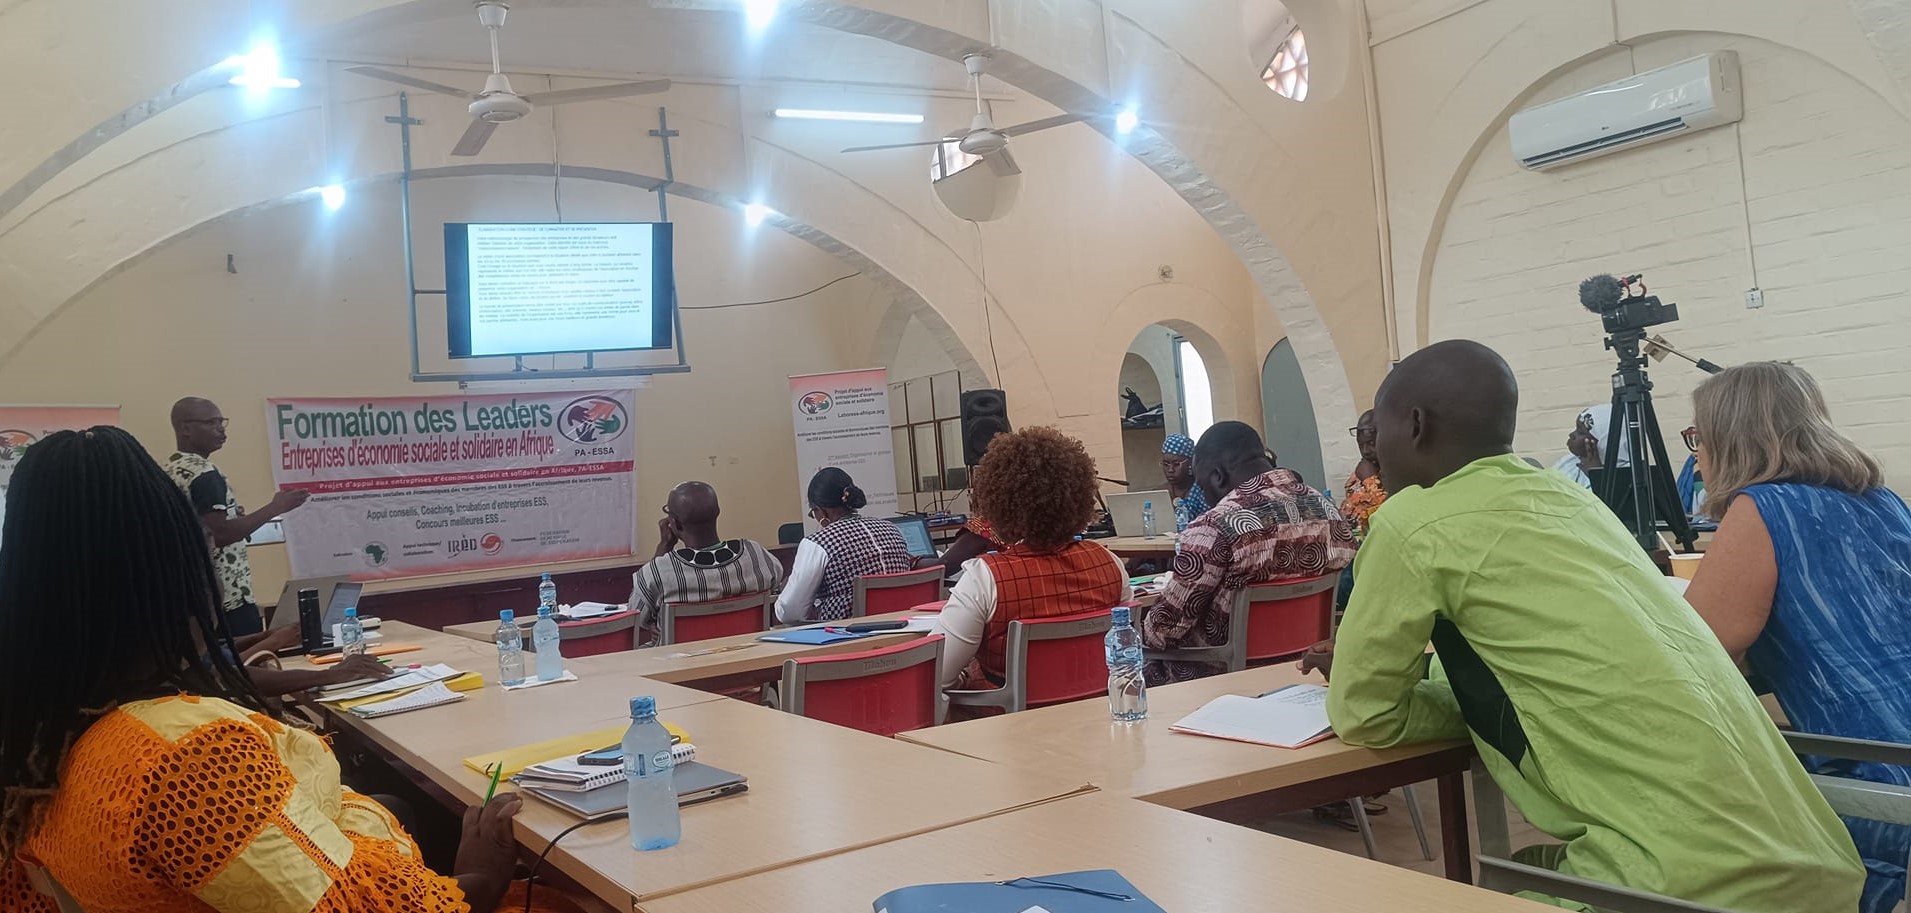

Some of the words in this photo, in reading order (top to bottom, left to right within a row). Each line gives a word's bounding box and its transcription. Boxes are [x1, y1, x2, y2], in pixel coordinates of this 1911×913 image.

[276, 403, 408, 440] Formation
[413, 402, 457, 434] des
[462, 398, 553, 431] Leaders
[281, 440, 345, 476] Entreprises
[349, 438, 409, 466] d'économie
[411, 435, 448, 464] sociale
[450, 435, 460, 460] et
[461, 431, 504, 460] solidaire
[505, 438, 519, 457] en
[519, 430, 554, 462] Afrique
[574, 448, 586, 457] PA
[592, 446, 615, 456] ESSA
[319, 481, 343, 490] Projet
[345, 480, 374, 488] d'appui
[390, 476, 432, 486] entreprises
[433, 474, 475, 482] d'économie
[475, 471, 500, 479] sociale
[510, 469, 540, 478] solidaire
[366, 508, 388, 521] Appui
[388, 506, 420, 518] conseils,
[421, 503, 455, 516] Coaching,
[456, 502, 491, 512] Incubation
[491, 498, 533, 511] d'entreprises
[415, 519, 449, 529] Concours
[449, 516, 484, 526] meilleures
[485, 513, 499, 524] ESS
